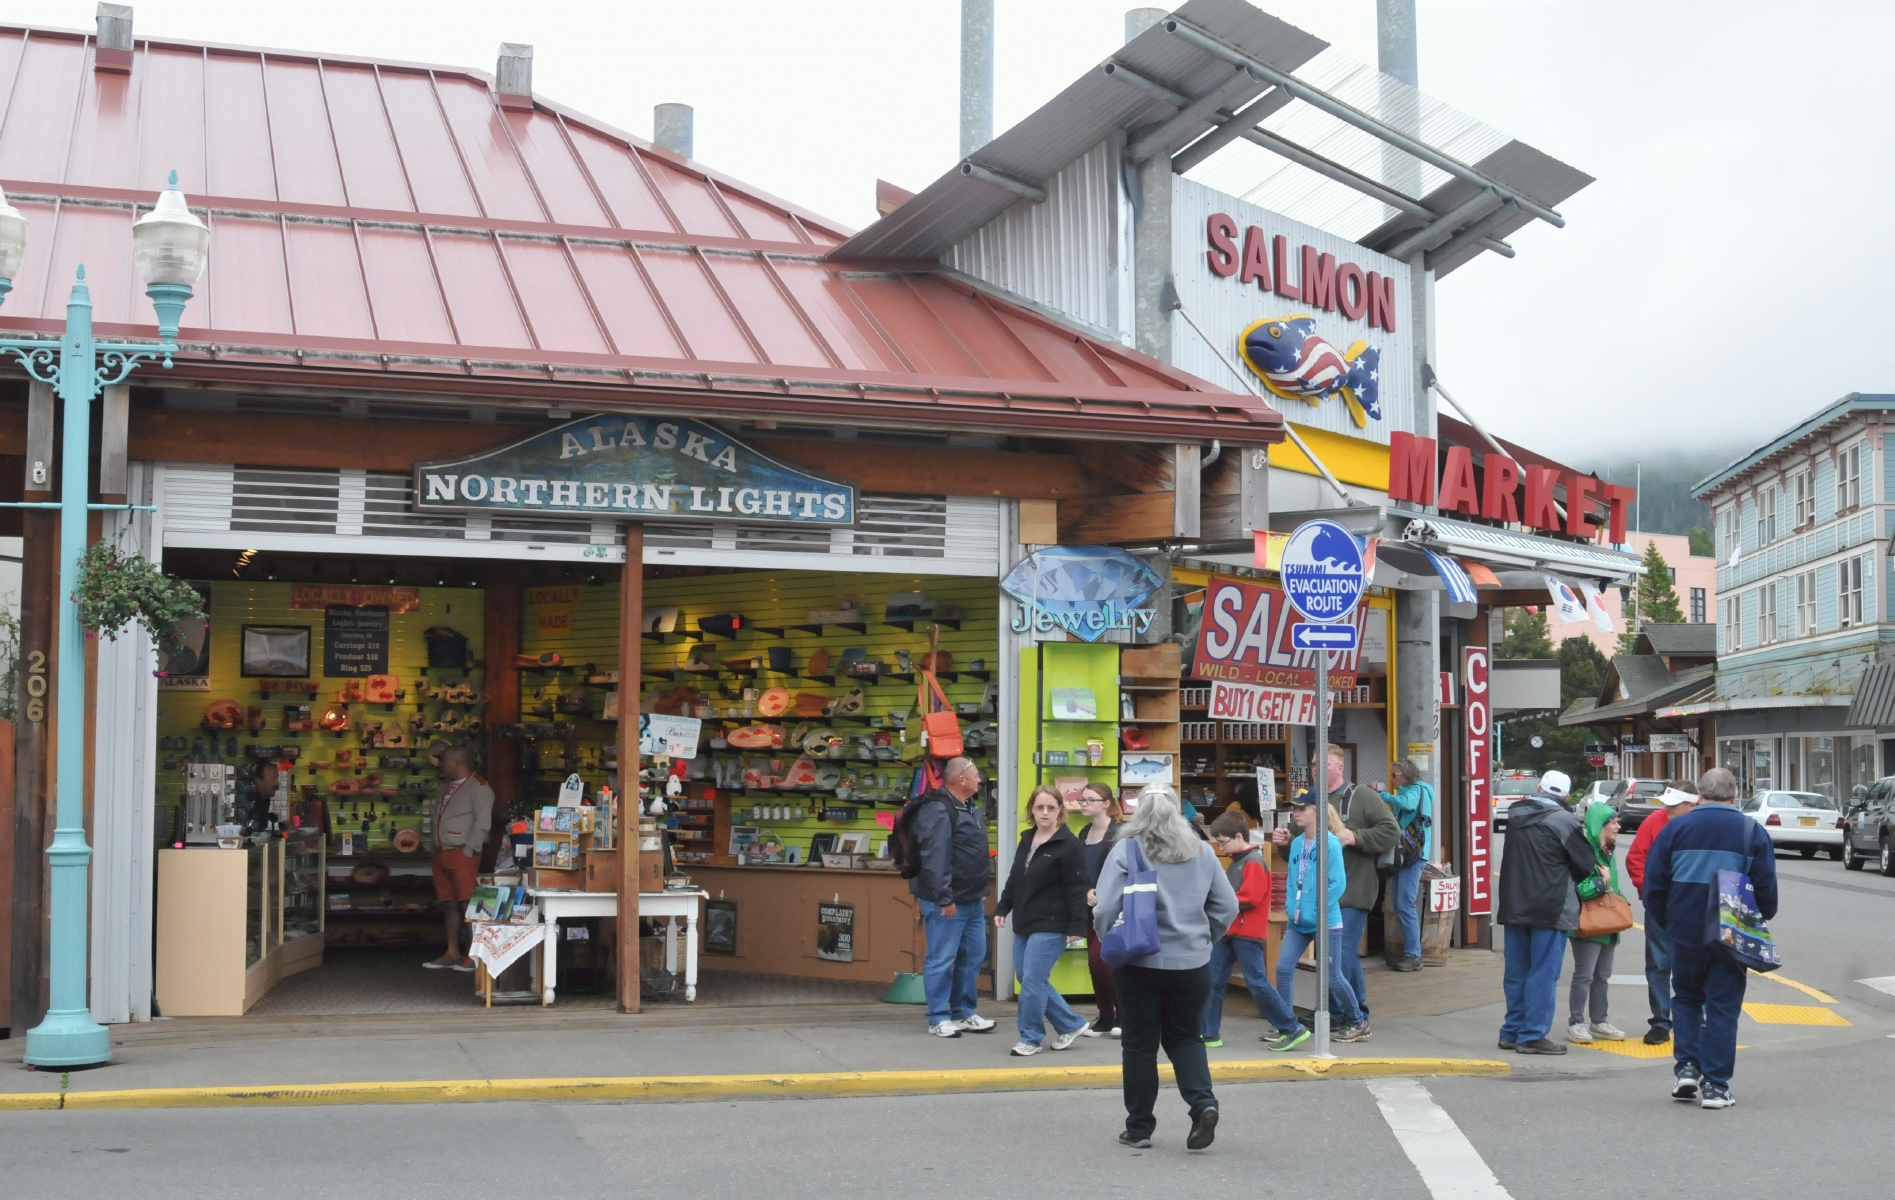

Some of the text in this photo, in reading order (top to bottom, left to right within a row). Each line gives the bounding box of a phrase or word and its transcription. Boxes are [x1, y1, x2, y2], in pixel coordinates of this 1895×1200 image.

[1207, 212, 1395, 333] SALMON
[560, 422, 737, 472] ALASKA
[1388, 431, 1635, 544] MARKET
[426, 474, 846, 519] NORTHERN LIGHTS
[1285, 564, 1326, 574] TSUNAMI
[1289, 579, 1358, 594] EVACUATION
[295, 588, 414, 603] LOCALLY OWNED
[530, 589, 579, 605] LOCALLY
[1306, 596, 1343, 610] ROUTE
[328, 608, 387, 617] Alaska Northern
[1011, 601, 1158, 634] Jewelry
[332, 619, 355, 628] Lights
[539, 615, 568, 629] MADE
[334, 641, 365, 651] Earrings
[334, 652, 364, 660] Pendant
[340, 664, 372, 673] Ring $25
[1200, 662, 1240, 680] WILD
[1256, 669, 1300, 687] LOCAL
[27, 650, 47, 722] 206
[1467, 652, 1487, 900] COFFEE
[1262, 785, 1268, 796] 5
[821, 907, 853, 918] COMPLAINT
[822, 915, 851, 925] DEPARTMENT
[838, 933, 850, 942] 300
